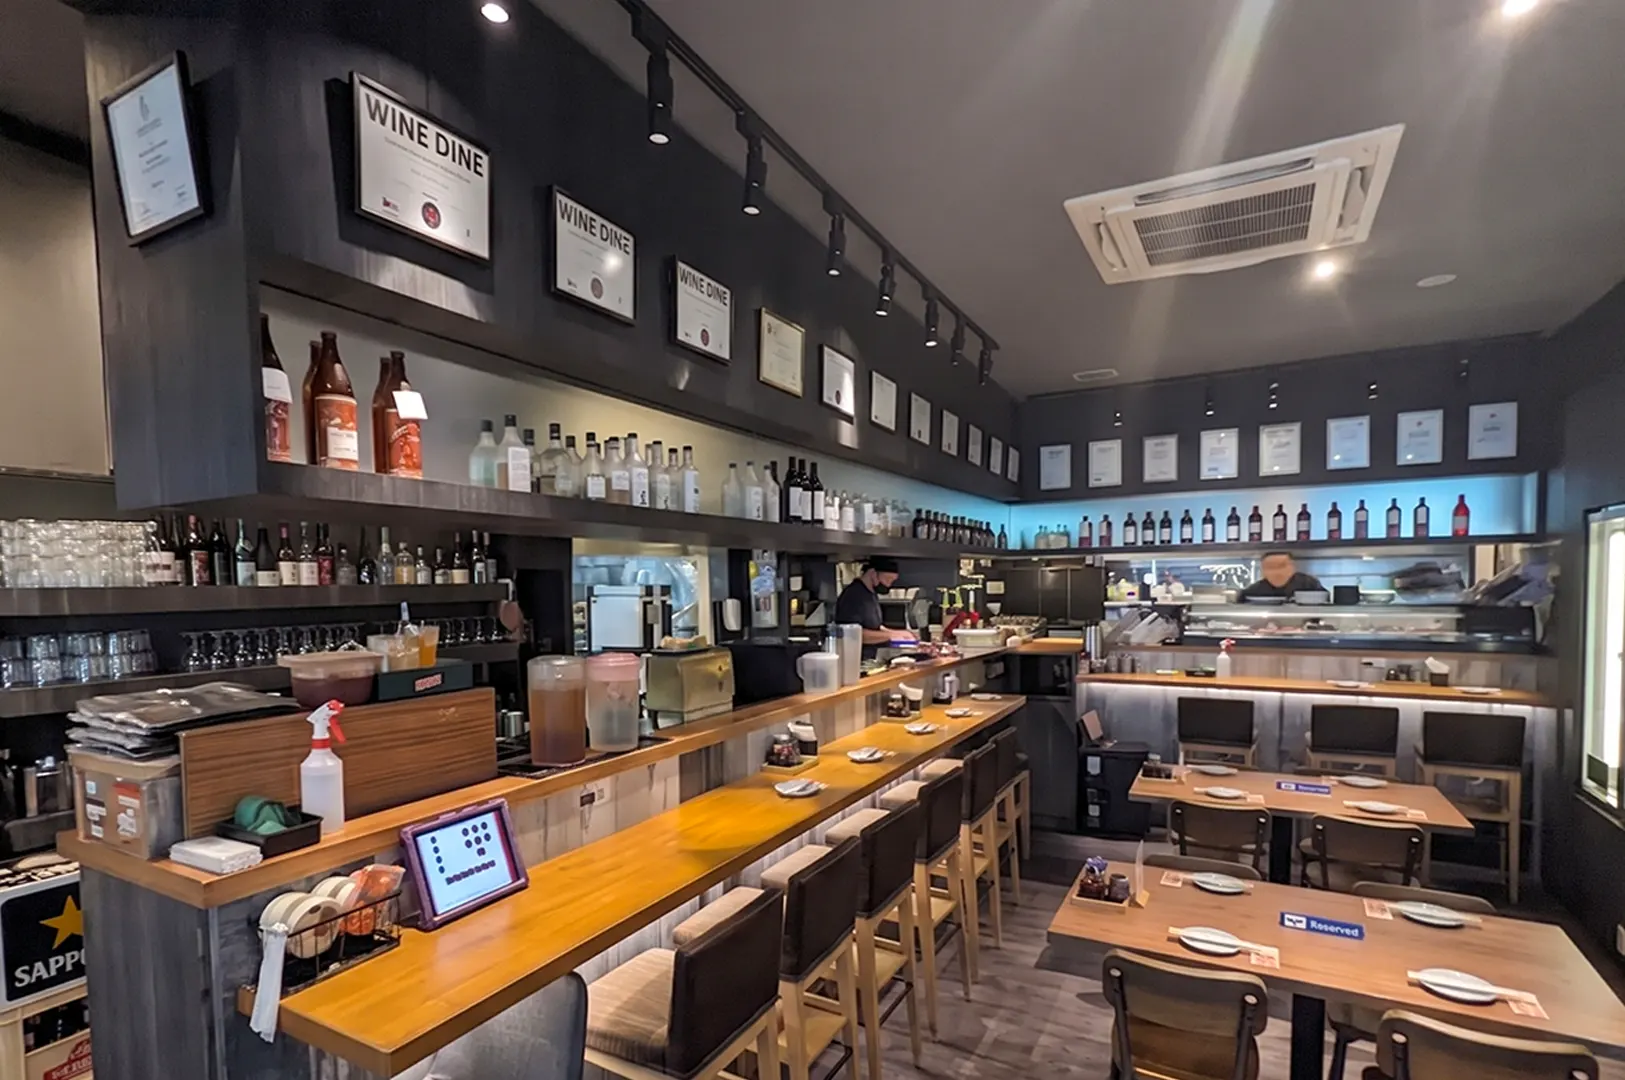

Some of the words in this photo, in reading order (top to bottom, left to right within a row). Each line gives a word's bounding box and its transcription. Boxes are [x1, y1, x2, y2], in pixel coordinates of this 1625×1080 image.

[365, 93, 429, 149] WINE
[435, 131, 483, 177] DINE
[559, 199, 597, 237] WINE
[600, 223, 630, 255] DINE
[680, 267, 704, 295] WINE
[706, 281, 728, 306] DINE
[1309, 920, 1360, 937] Reserved
